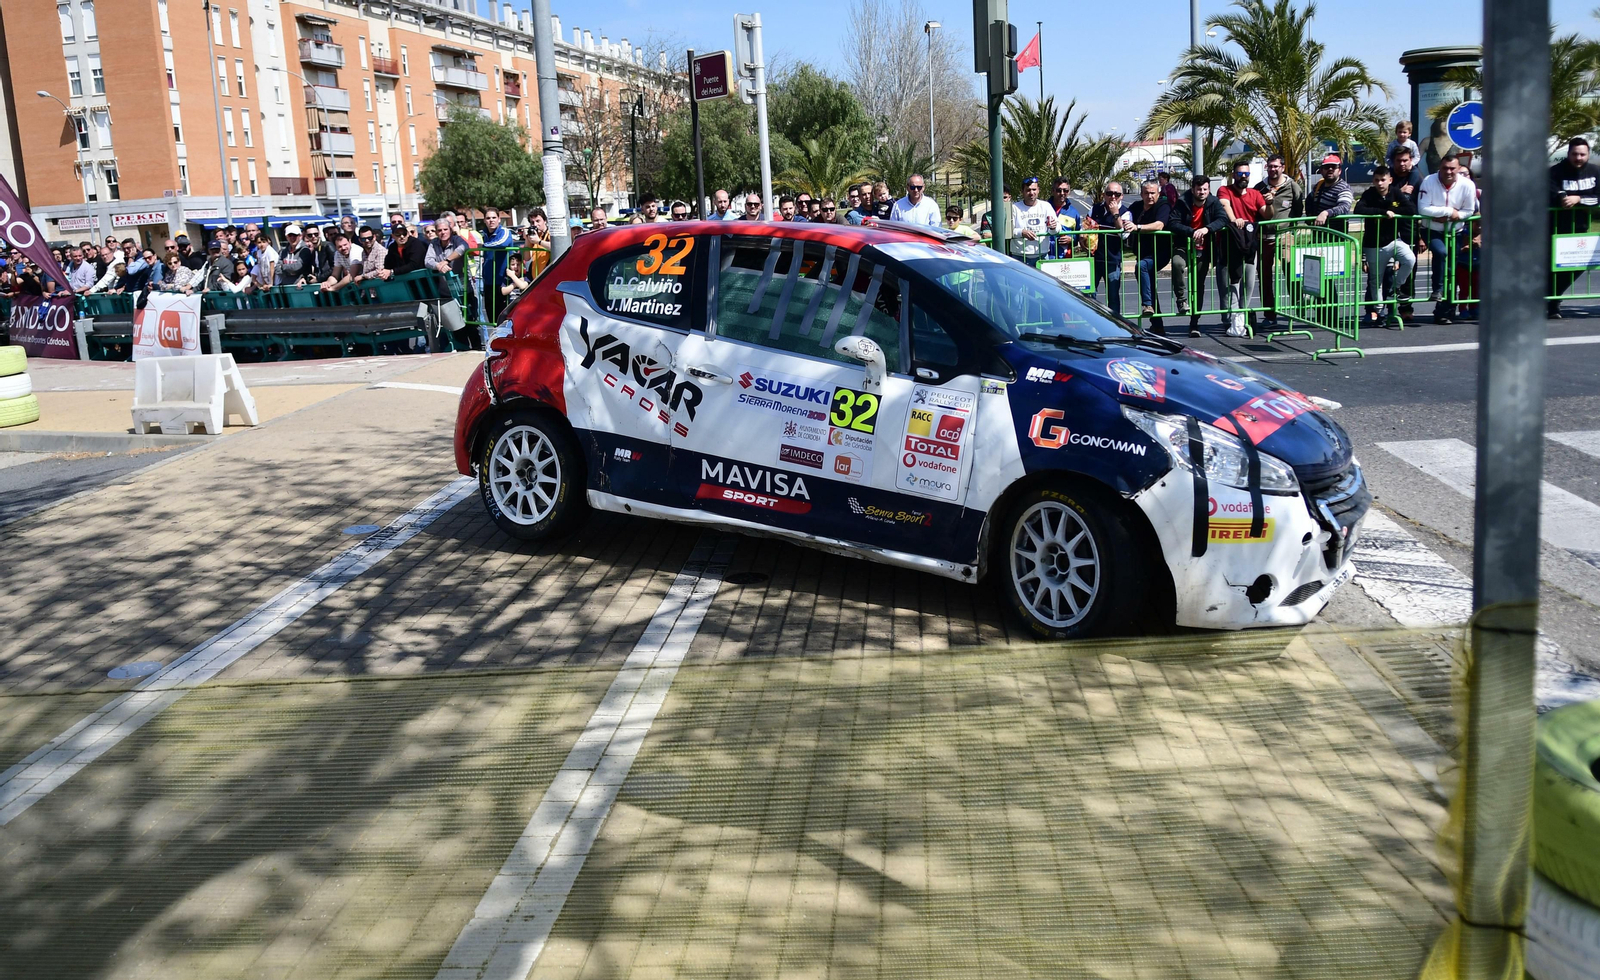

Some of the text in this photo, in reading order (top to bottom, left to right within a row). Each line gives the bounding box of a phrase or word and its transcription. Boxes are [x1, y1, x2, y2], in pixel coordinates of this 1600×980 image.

[703, 76, 719, 84] Puente
[708, 85, 724, 94] Arenal
[115, 213, 165, 221] PEKIN
[636, 233, 695, 275] 32
[16, 305, 70, 332] IMDCO
[161, 320, 178, 341] lar
[47, 337, 70, 347] Córdoba
[580, 316, 703, 422] YACAR
[1027, 366, 1073, 382] MRW
[754, 377, 831, 405] SUZUKI
[930, 392, 972, 403] PEUGEOT
[603, 373, 689, 438] CROSS
[928, 397, 971, 409] RALLY CUP
[830, 389, 879, 433] 32
[911, 410, 932, 422] RACC
[799, 425, 827, 436] AYUNTAMIENTO
[940, 428, 960, 441] acp
[845, 434, 873, 445] Diputación
[1070, 433, 1147, 456] GONCAMAN
[851, 443, 872, 452] Córdoba
[908, 438, 956, 458] TOTAL
[790, 449, 823, 463] IMDECO
[836, 460, 849, 472] lar
[918, 460, 957, 474] vodafone
[701, 458, 811, 500] MAVISA
[919, 477, 951, 491] moura
[722, 489, 778, 507] SPORT
[1220, 502, 1270, 514] vodafe
[864, 506, 894, 518] Senra
[895, 511, 925, 525] Sport
